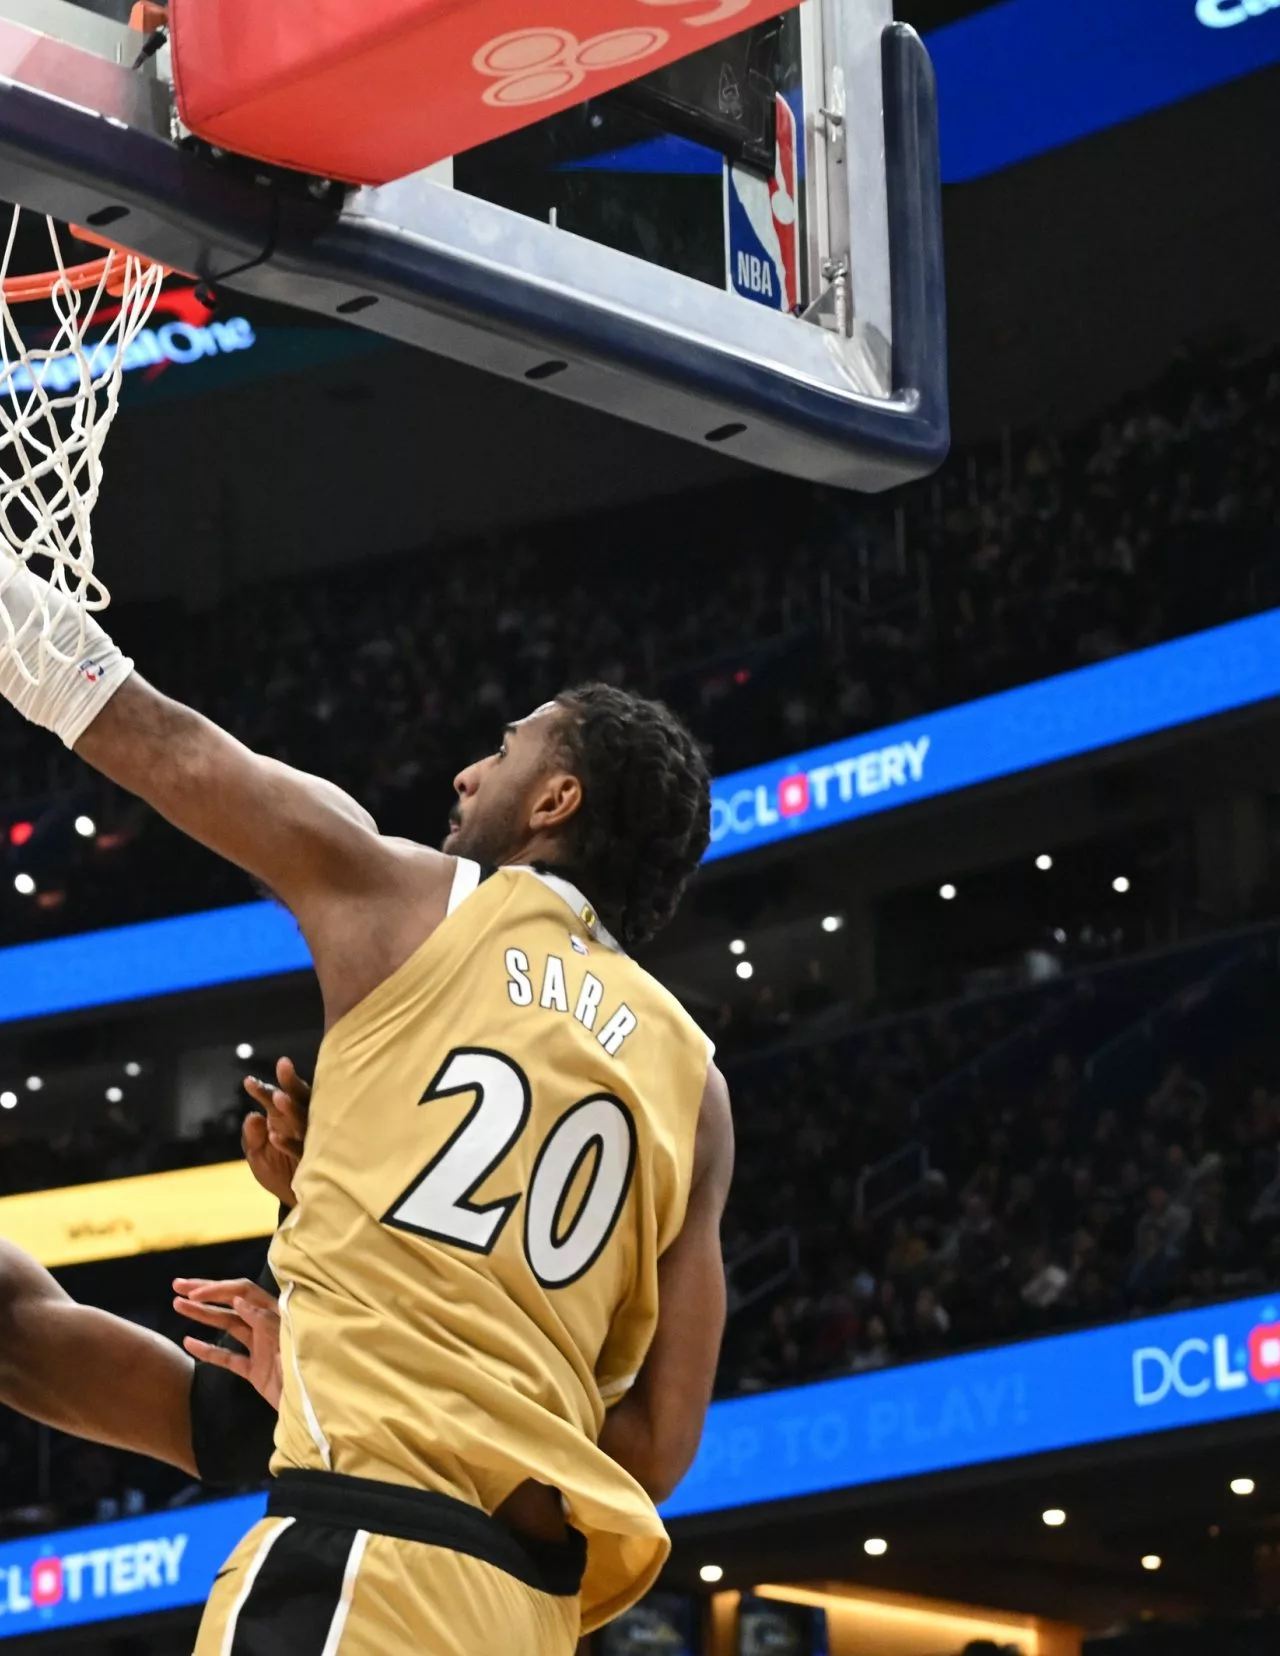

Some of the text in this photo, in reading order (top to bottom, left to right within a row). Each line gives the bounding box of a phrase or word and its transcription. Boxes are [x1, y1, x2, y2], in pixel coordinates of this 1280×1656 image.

[737, 250, 773, 297] NBA
[504, 947, 638, 1057] SARR
[379, 1045, 638, 1290] 20
[775, 1410, 850, 1469] TO
